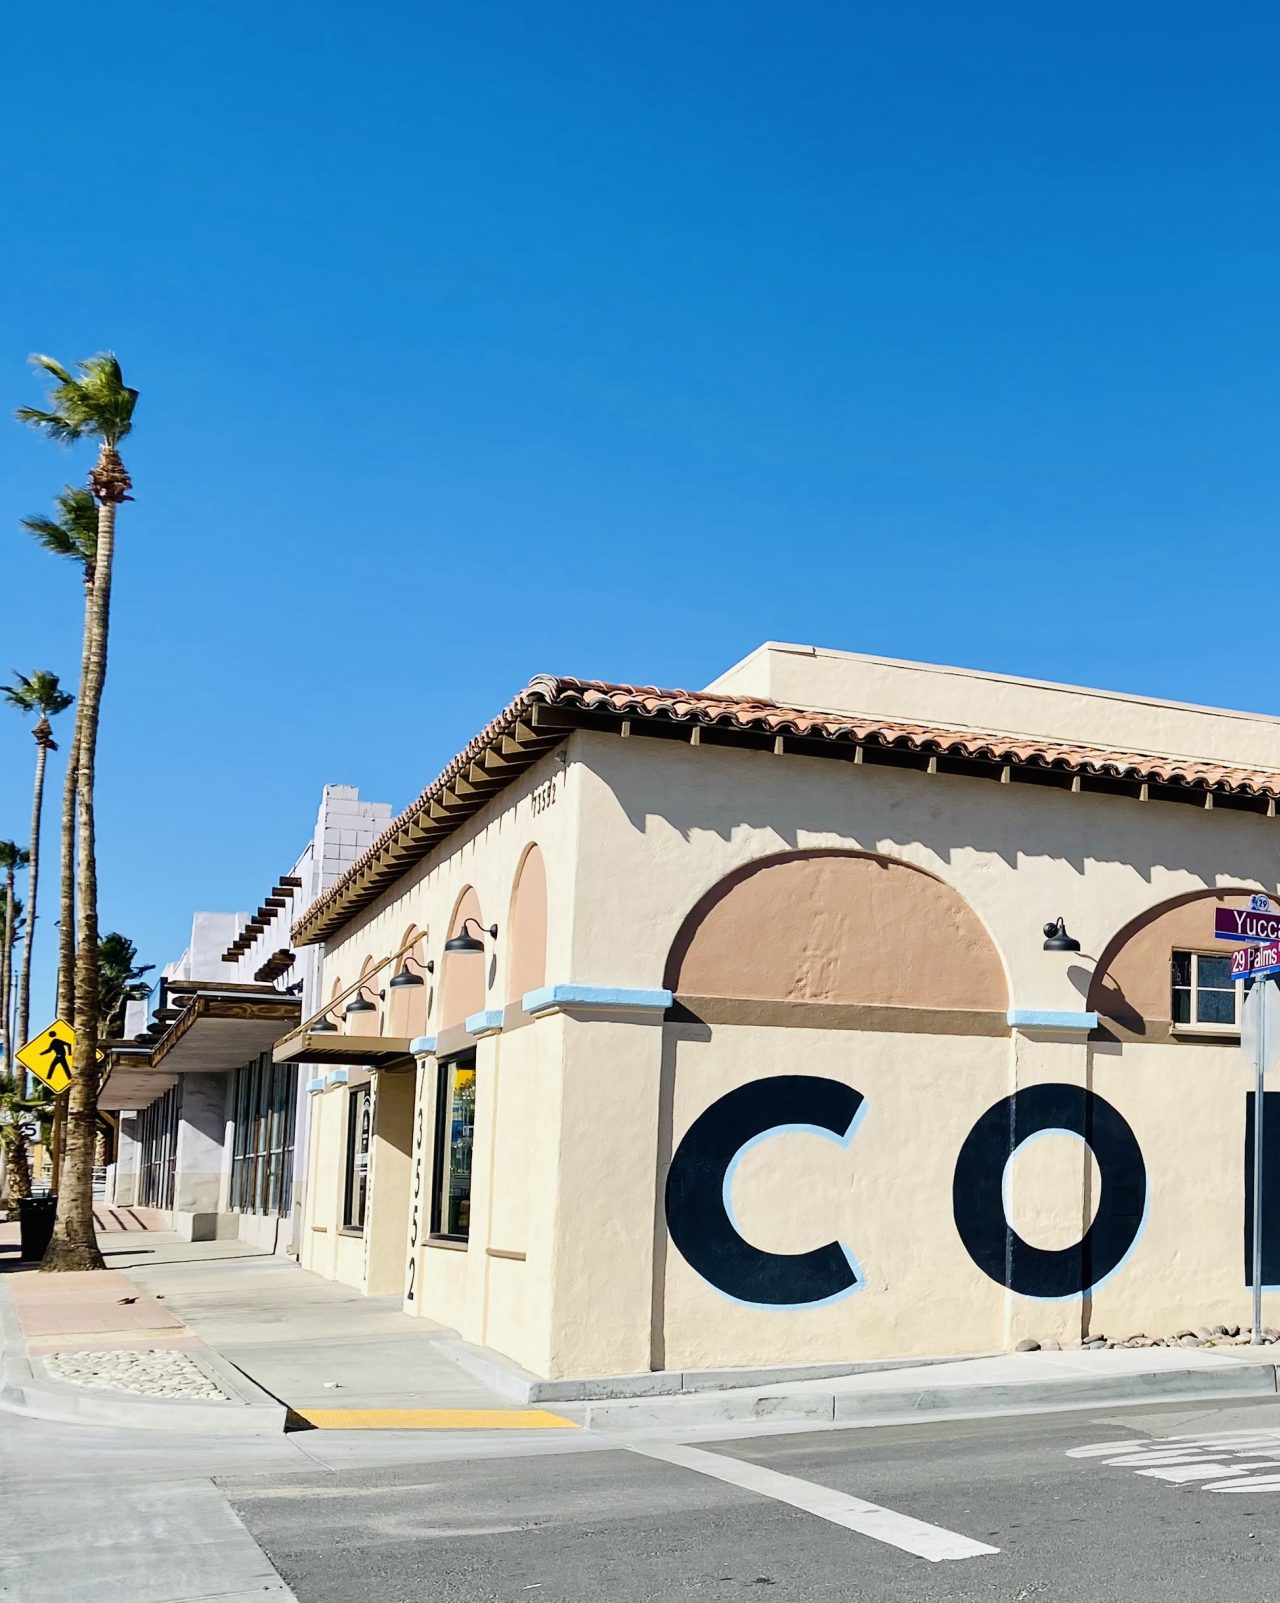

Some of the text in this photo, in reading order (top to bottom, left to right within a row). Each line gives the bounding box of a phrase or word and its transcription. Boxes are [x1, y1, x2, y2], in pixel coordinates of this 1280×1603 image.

[1232, 950, 1245, 972] 29
[1247, 947, 1278, 970] Palms
[21, 1123, 37, 1137] 5
